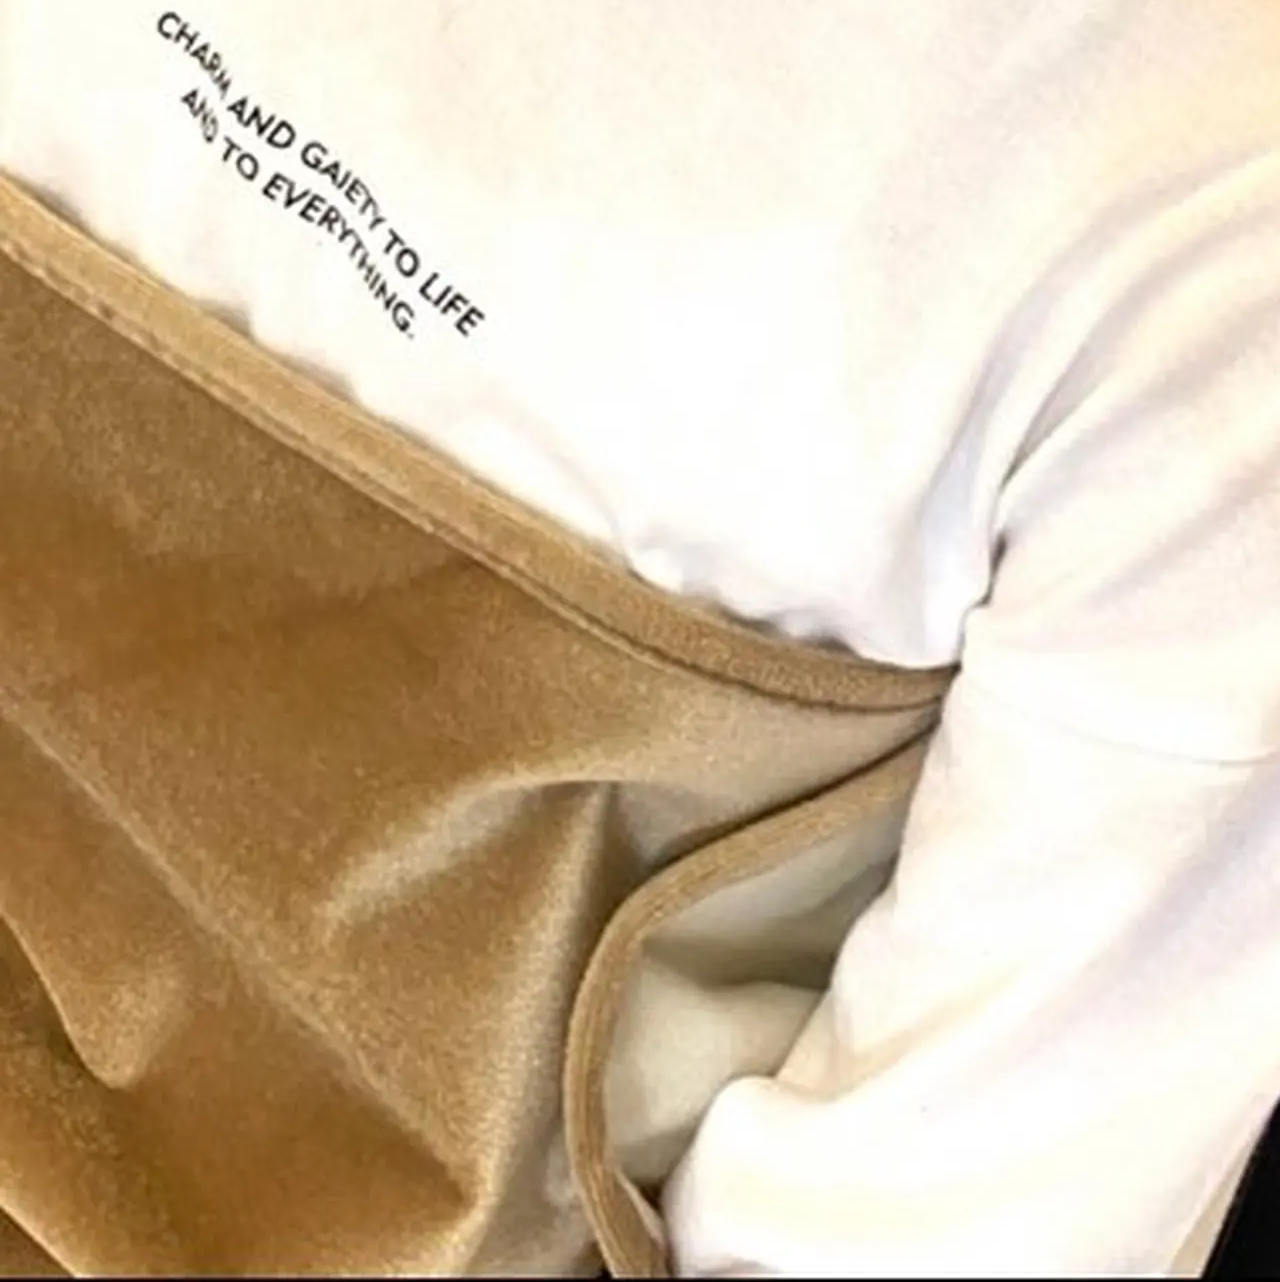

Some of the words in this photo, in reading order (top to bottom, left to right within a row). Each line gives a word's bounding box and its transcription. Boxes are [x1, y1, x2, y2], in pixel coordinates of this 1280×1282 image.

[156, 11, 231, 100] CHARM
[227, 96, 296, 150] AND
[300, 141, 385, 230] GAIETY
[383, 229, 419, 278] TO
[419, 272, 485, 337] LIFE
[181, 88, 218, 142] AND
[221, 136, 259, 181] TO
[262, 173, 416, 339] EVERYTHING.
